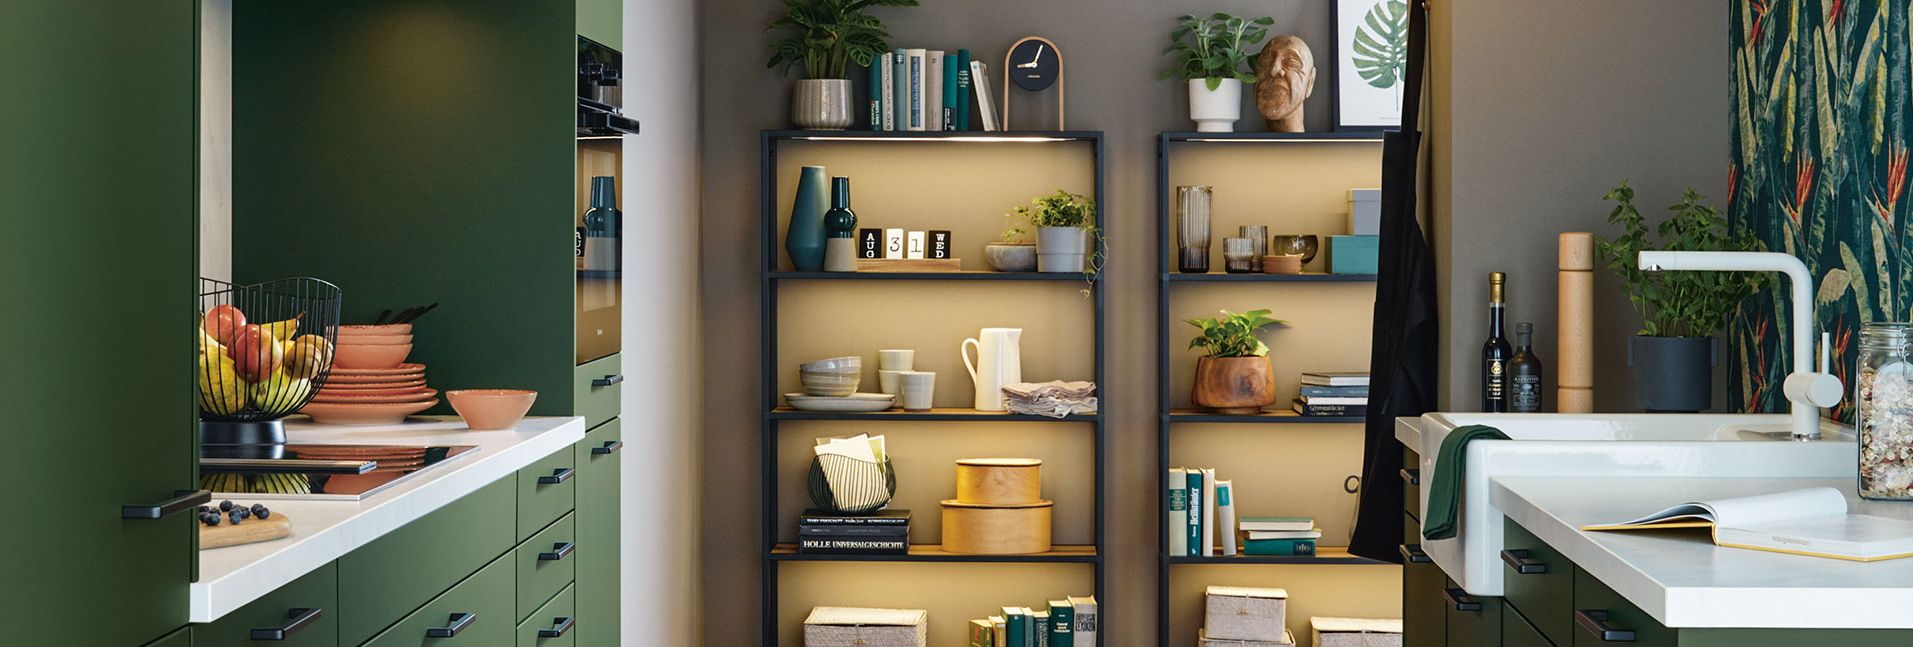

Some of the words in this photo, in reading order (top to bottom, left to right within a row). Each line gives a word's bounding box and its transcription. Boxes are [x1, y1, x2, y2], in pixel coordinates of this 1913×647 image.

[866, 232, 875, 258] AUG
[935, 233, 946, 258] WED
[833, 541, 904, 549] UNIVERSALGESCHICHTE
